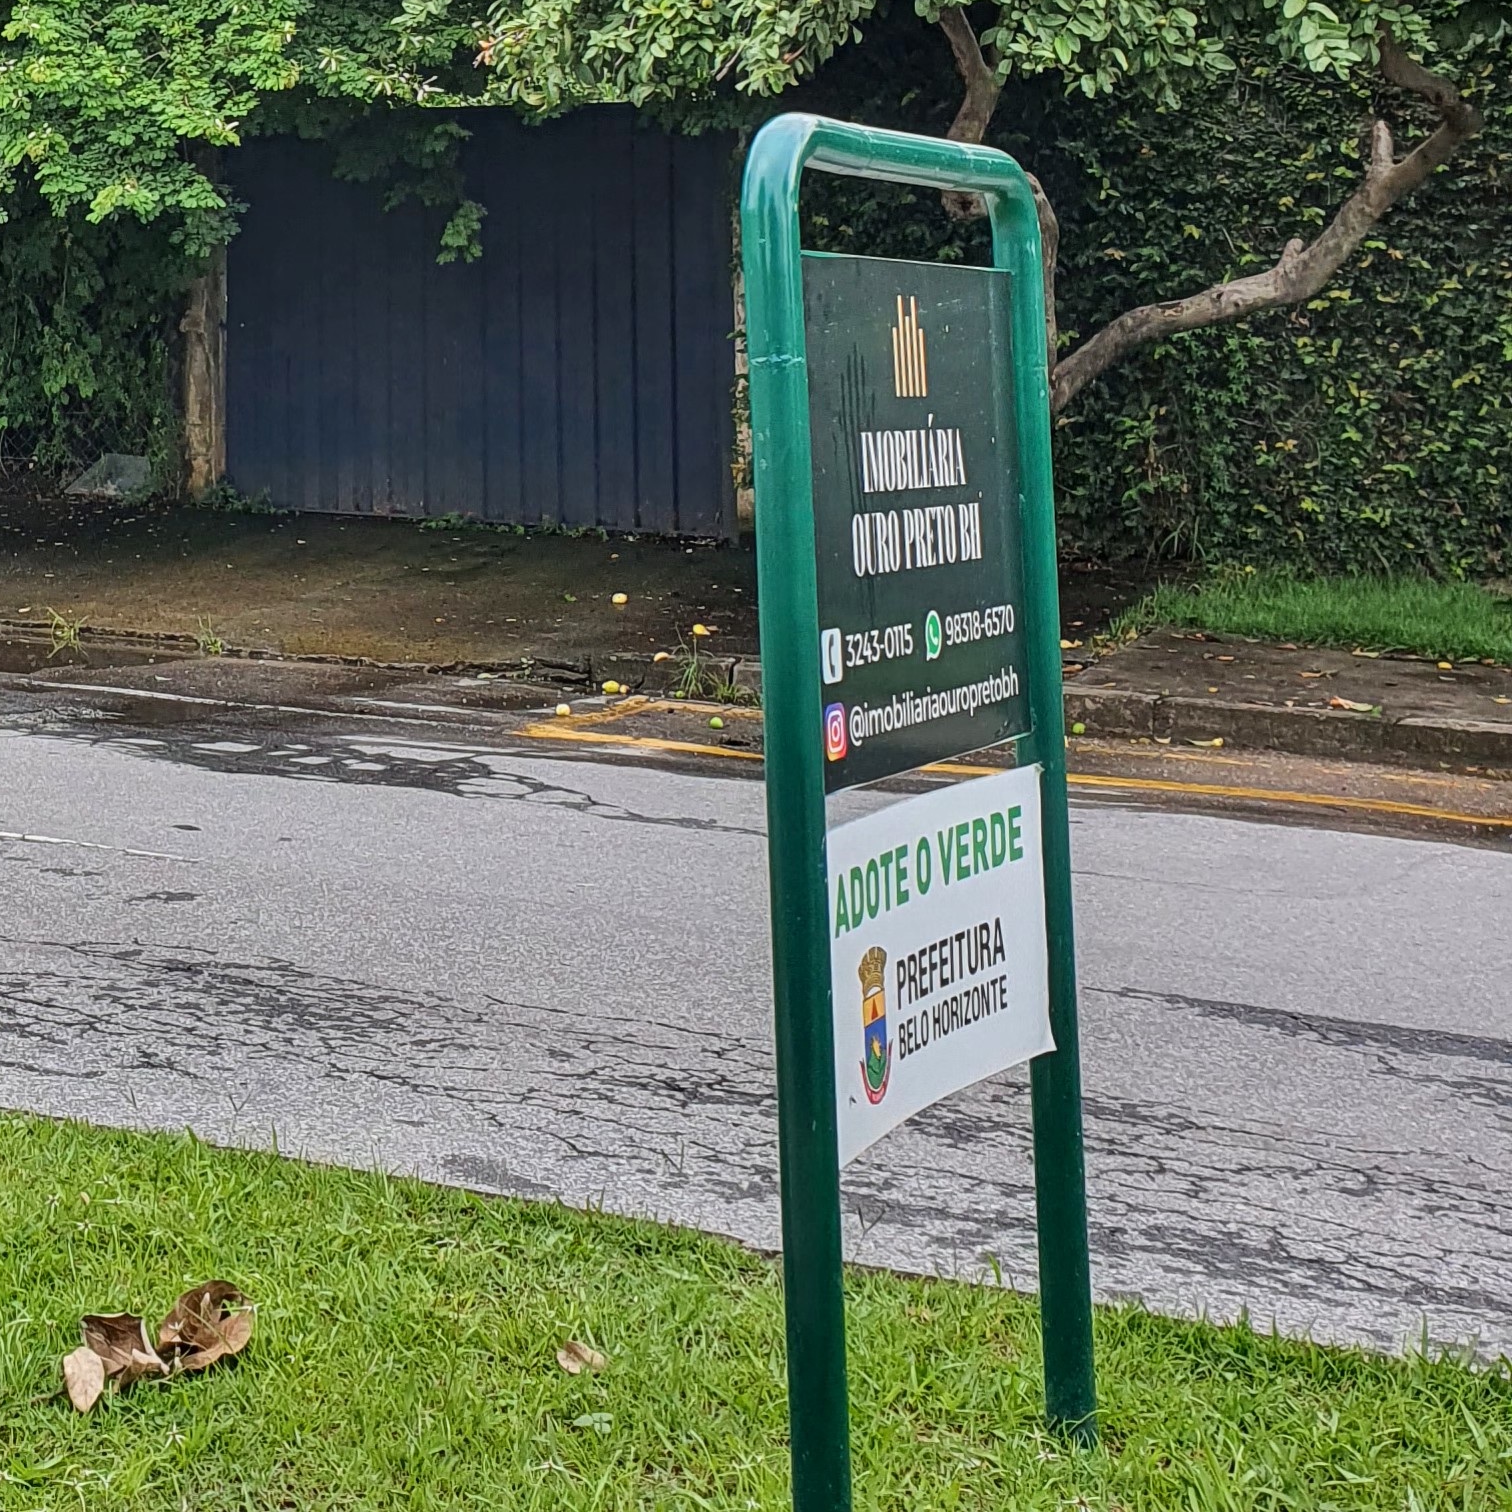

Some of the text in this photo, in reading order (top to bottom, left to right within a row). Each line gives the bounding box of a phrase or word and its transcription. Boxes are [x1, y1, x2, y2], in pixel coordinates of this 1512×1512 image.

[860, 414, 967, 494] IMOBILIÁRIA
[852, 502, 982, 578] OURO PRETO BH
[845, 604, 1015, 668] 3243-0115 98318-6570
[849, 665, 1019, 747] @imobiliariaouropretobh
[835, 805, 1024, 939] ADOTE O VERDE
[896, 917, 1006, 1010] PREFEITURA
[898, 974, 1008, 1061] BELO HORIZONTE
